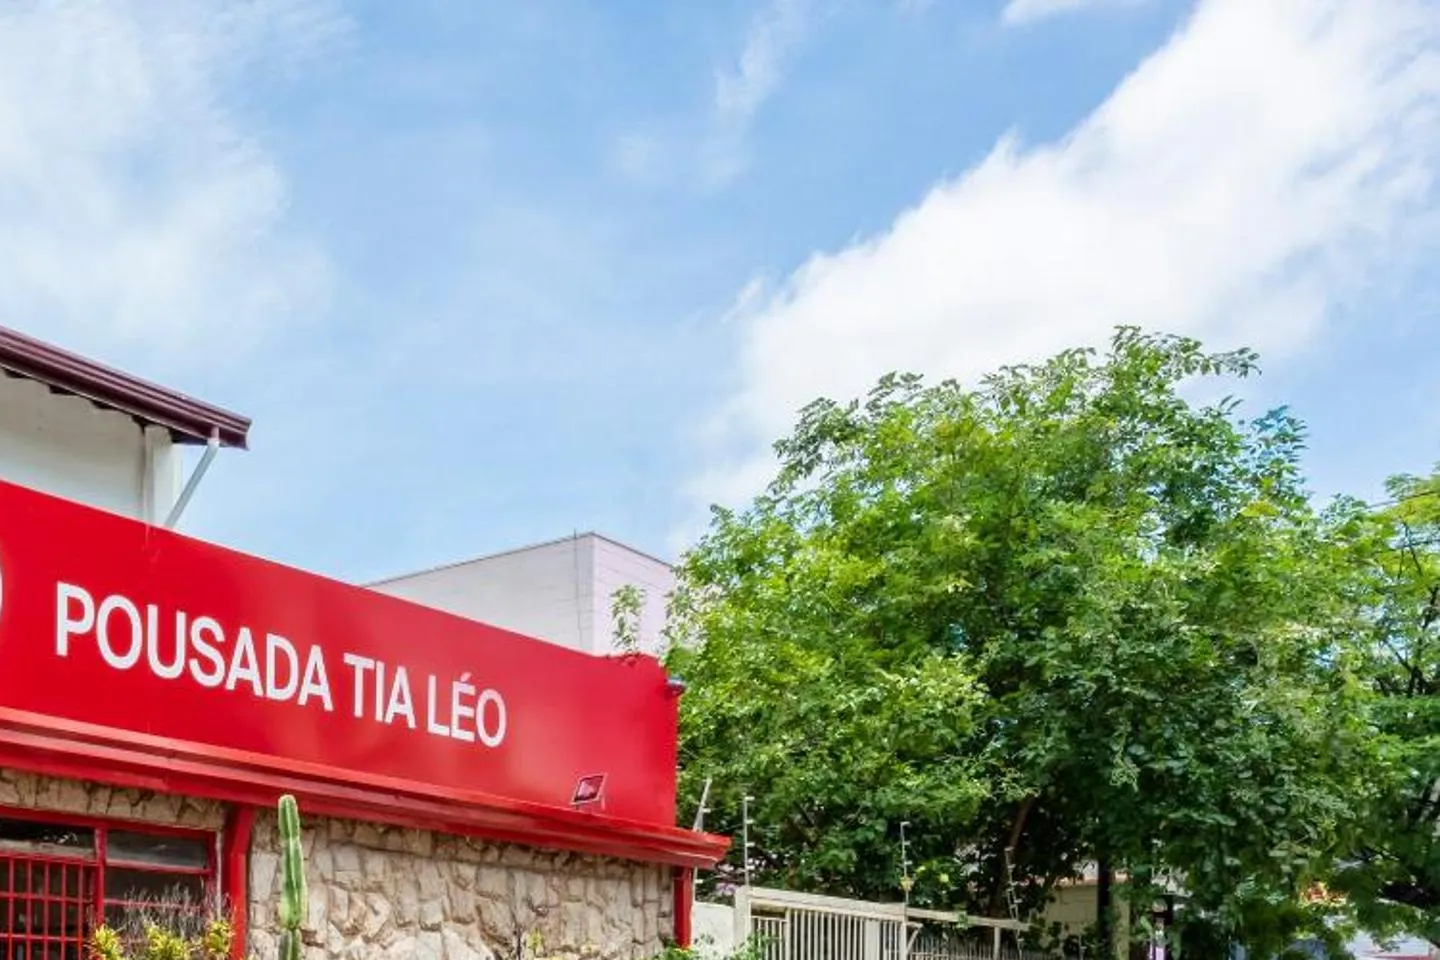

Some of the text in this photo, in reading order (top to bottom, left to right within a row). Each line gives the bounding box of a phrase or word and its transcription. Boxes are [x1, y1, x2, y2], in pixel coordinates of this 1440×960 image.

[56, 581, 333, 711] POUSADA
[343, 653, 416, 729] TIA
[426, 672, 507, 748] LÉO
